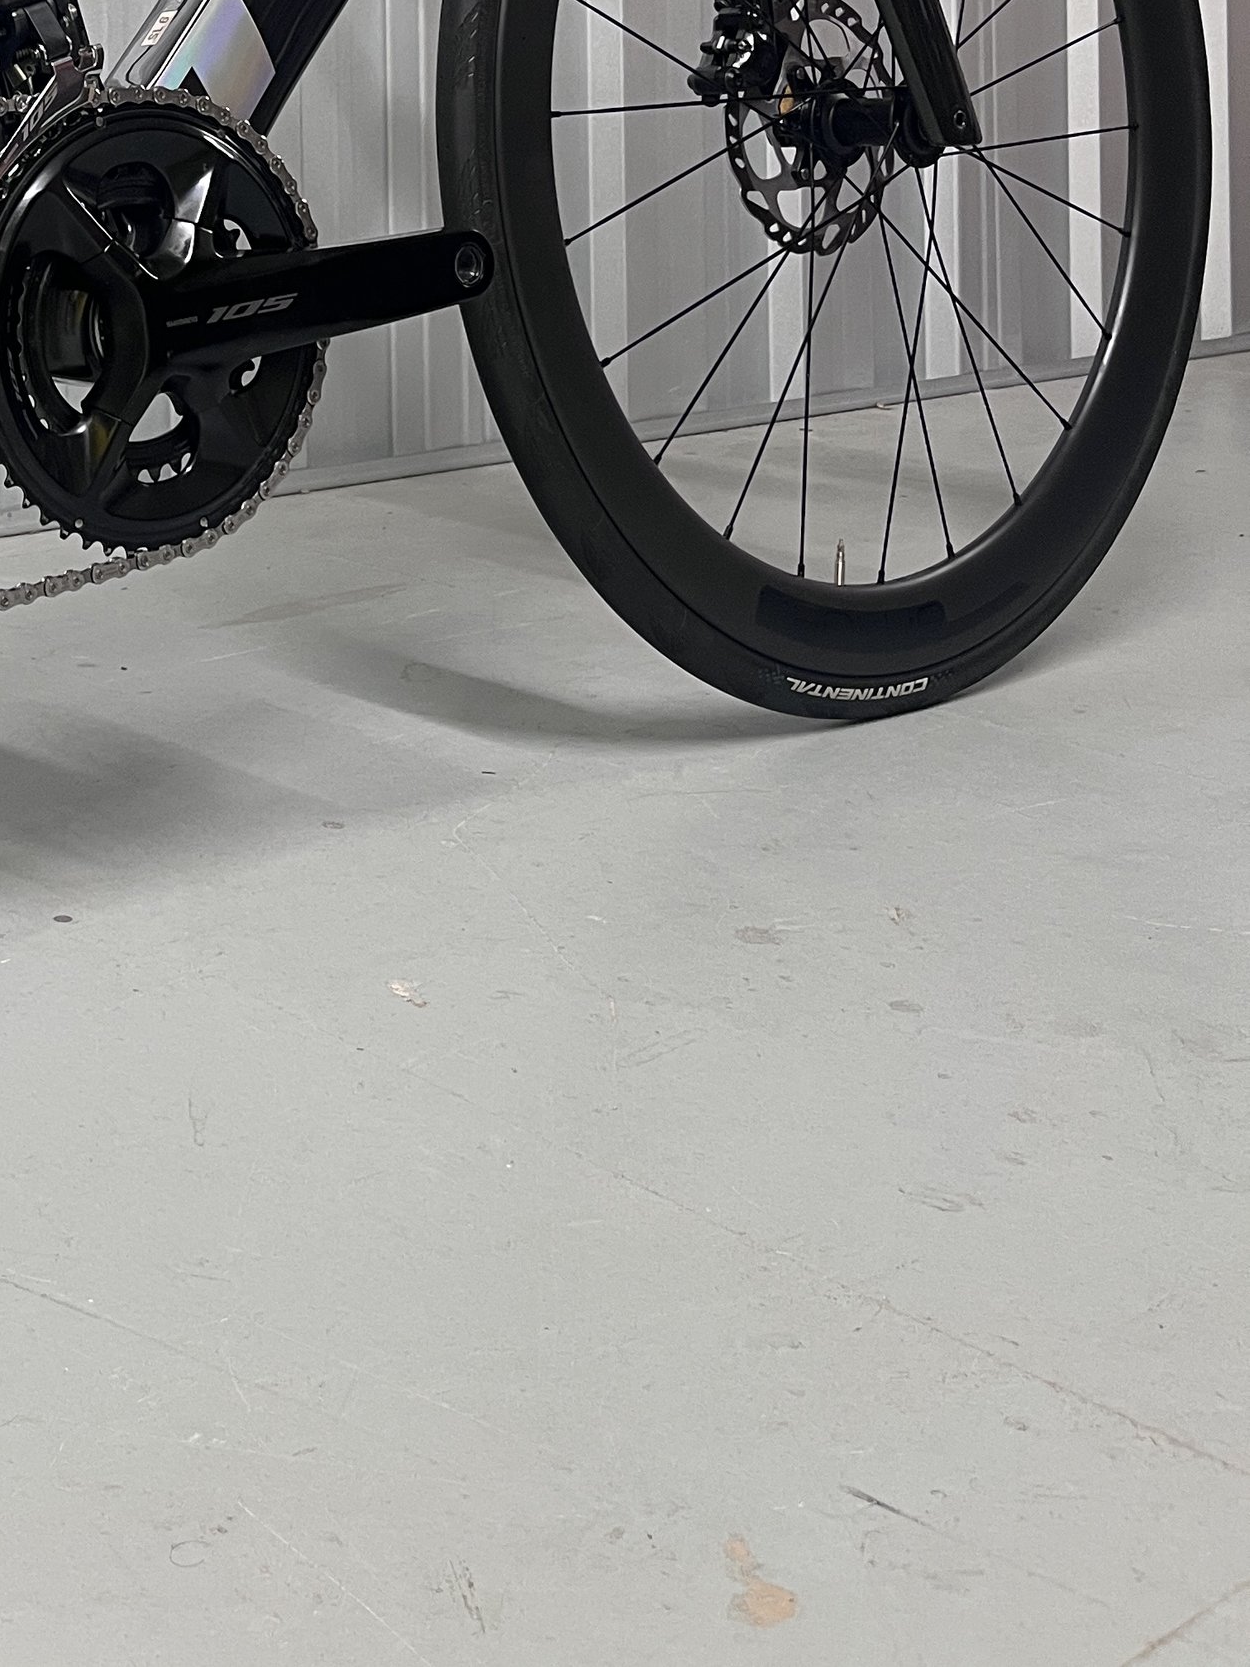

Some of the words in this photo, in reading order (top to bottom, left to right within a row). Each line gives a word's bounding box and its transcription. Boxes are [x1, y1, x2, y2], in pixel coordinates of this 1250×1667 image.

[21, 82, 58, 142] 105
[206, 292, 299, 324] 105
[786, 677, 929, 701] CONTINENTAL
